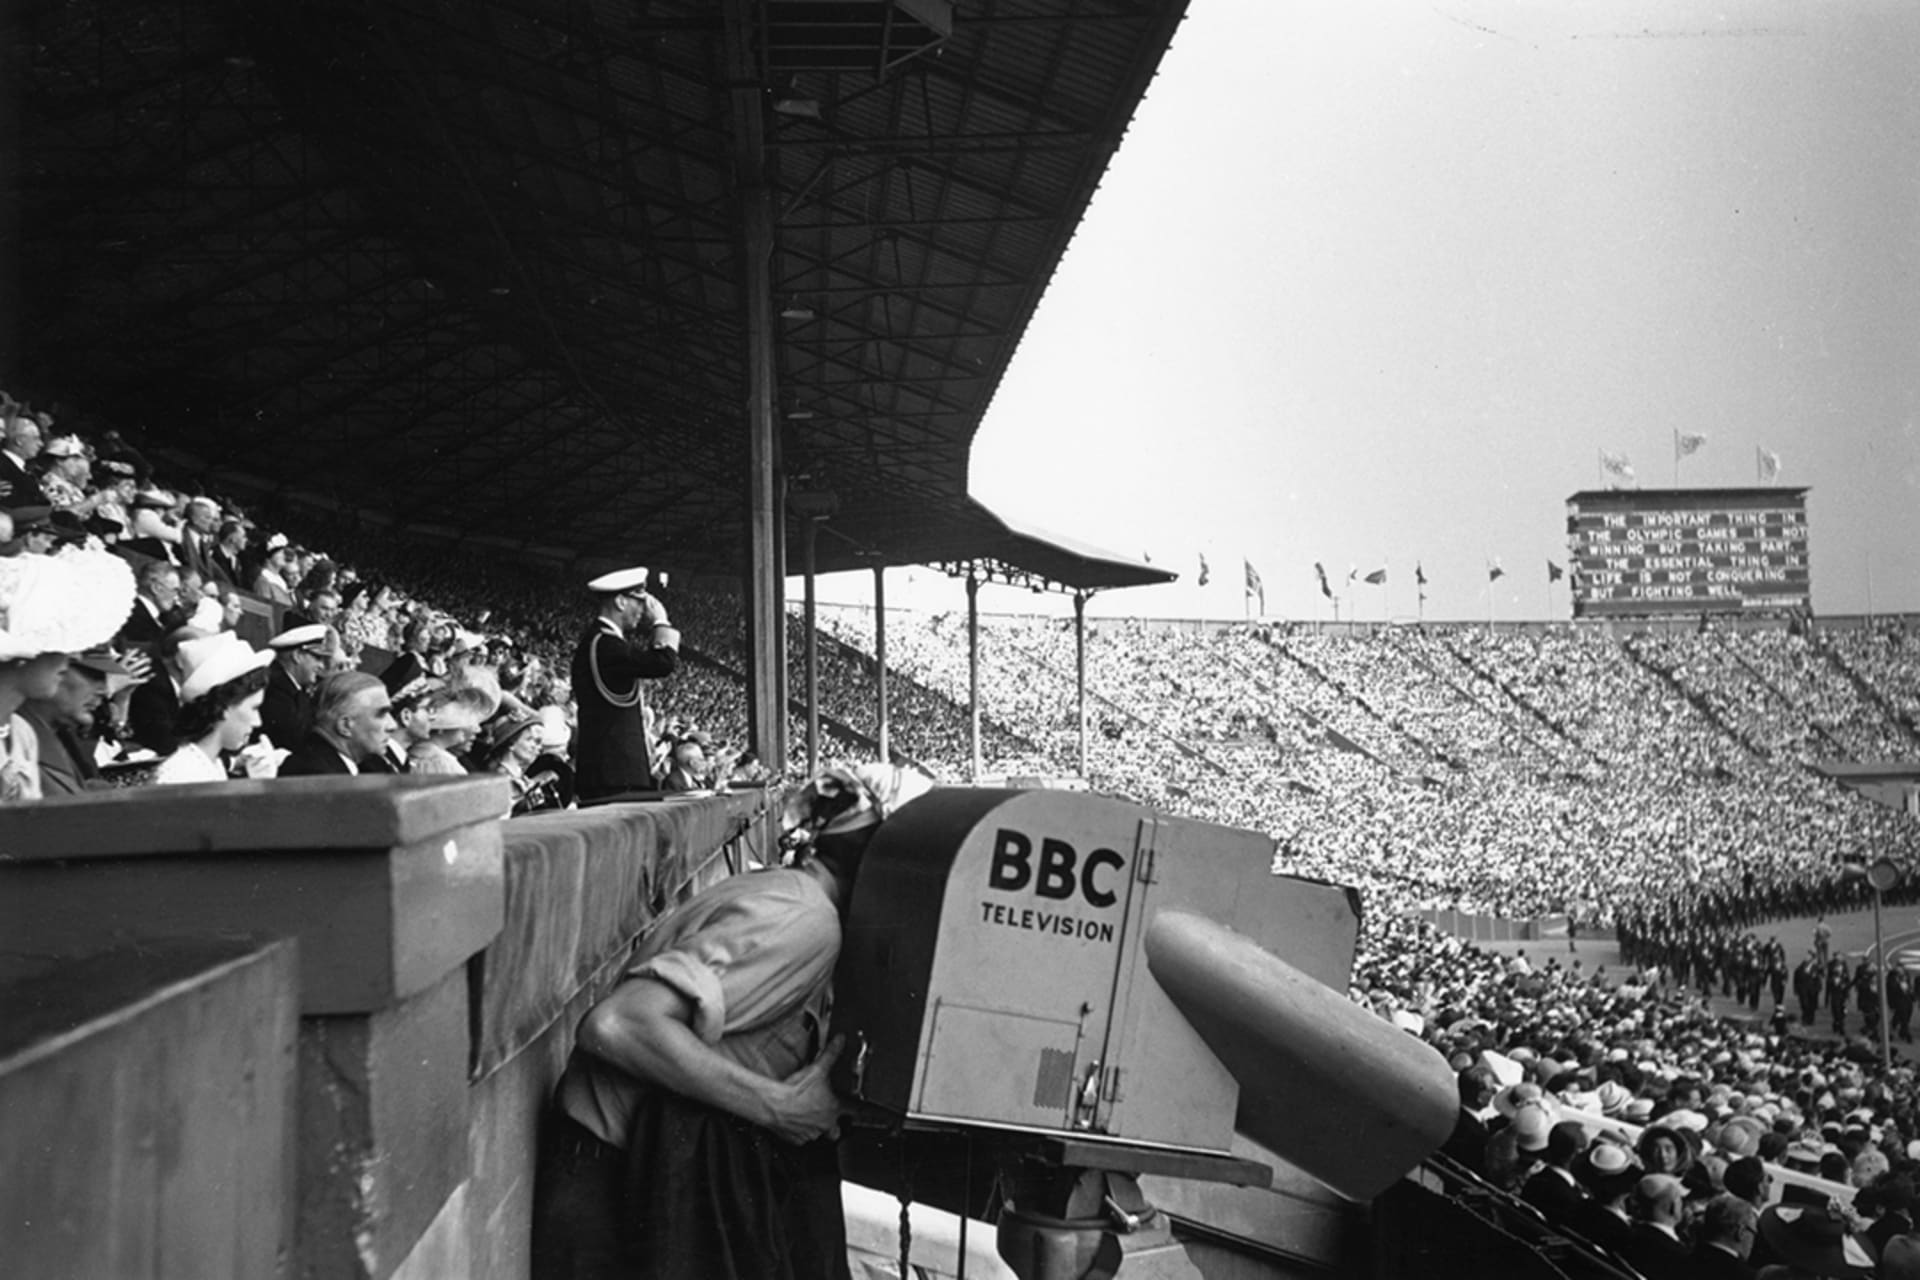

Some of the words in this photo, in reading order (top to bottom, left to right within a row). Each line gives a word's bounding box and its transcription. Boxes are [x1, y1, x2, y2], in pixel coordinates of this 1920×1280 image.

[1604, 515, 1626, 528] THE
[1643, 513, 1711, 527] IMPORTANT
[1728, 512, 1766, 525] THING
[1782, 512, 1796, 523] IN
[1588, 530, 1611, 541] THE
[1627, 528, 1682, 541] OLYMPIC
[1697, 528, 1737, 539] GAMES
[1753, 527, 1766, 538] IS
[1782, 526, 1807, 537] NOT
[1589, 545, 1645, 555] WINNING
[1660, 543, 1682, 554] BUT
[1699, 542, 1746, 553] TAKING
[1761, 541, 1794, 552] PART.
[1606, 558, 1629, 570] THE
[1645, 556, 1714, 569] ESSENTIAL
[1730, 555, 1769, 567] THING
[1785, 555, 1799, 565] IN
[1592, 572, 1622, 585] LIFE
[1640, 571, 1652, 583] IS
[1669, 571, 1692, 582] NOT
[1707, 568, 1786, 582] CONQUERING
[1591, 587, 1614, 599] BUT
[1631, 585, 1693, 598] FIGHTING
[989, 828, 1126, 908] BBC
[981, 901, 1114, 943] TELEVISION
